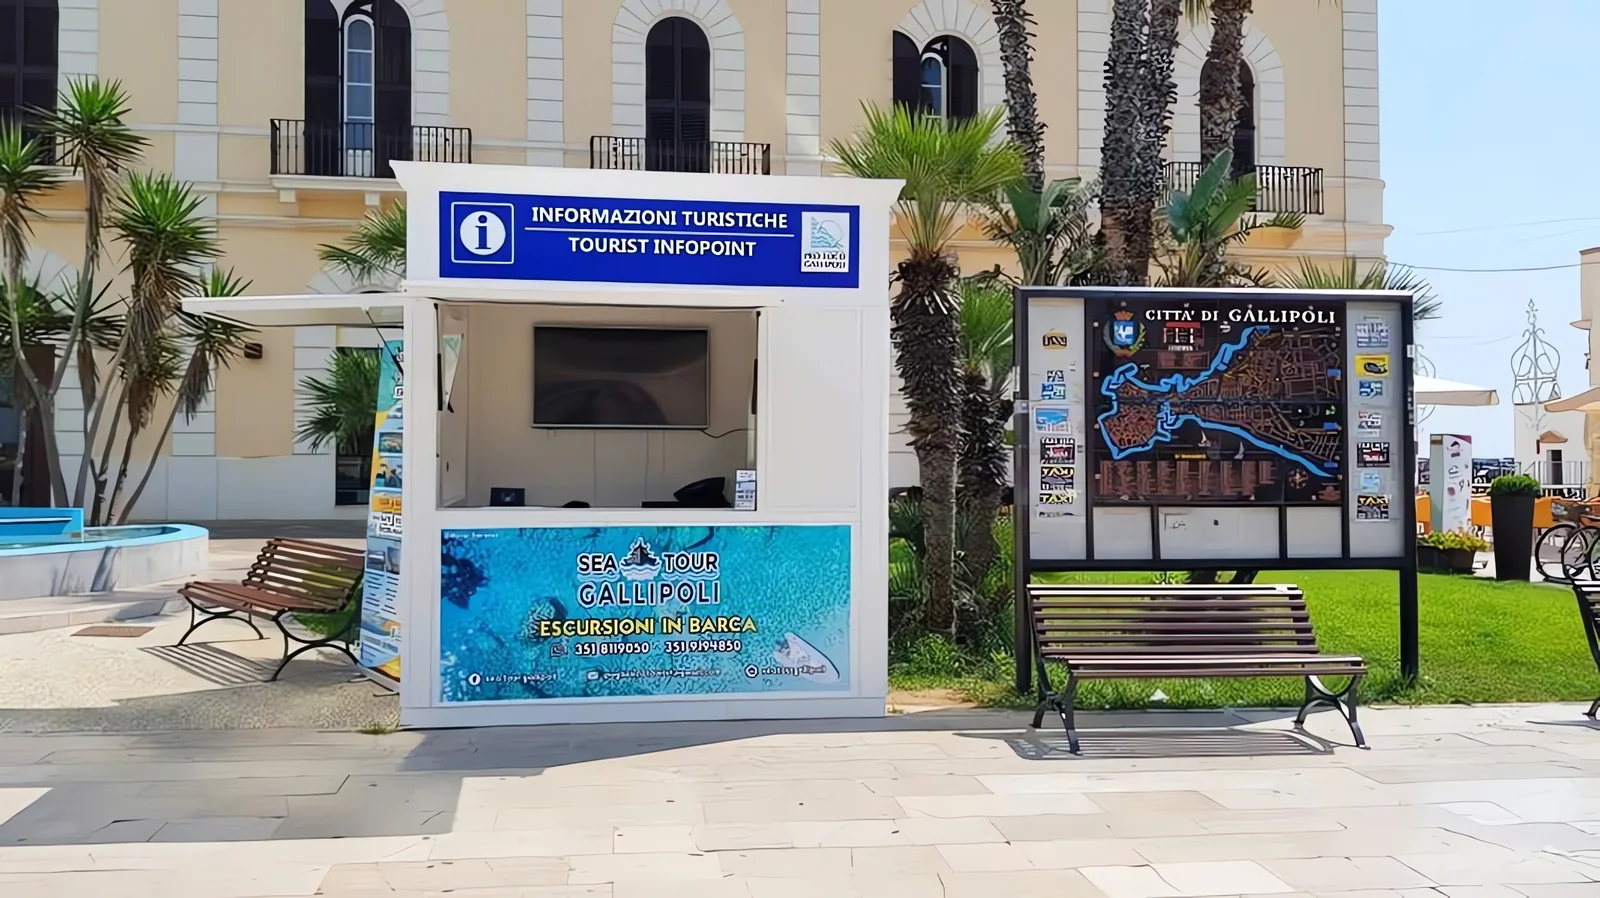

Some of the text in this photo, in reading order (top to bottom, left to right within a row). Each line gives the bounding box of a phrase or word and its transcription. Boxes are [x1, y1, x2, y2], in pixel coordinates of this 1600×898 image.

[531, 206, 788, 228] INFORMAZIONI TURISTICHE
[568, 236, 757, 257] TOURIST INFOPOINT
[1201, 310, 1218, 321] DI
[1228, 308, 1335, 323] GALLIPOLI
[578, 553, 719, 573] SEA TOUR
[579, 581, 720, 606] GALLIPOLI
[539, 616, 758, 636] ESCURSIONI IN BARCA
[575, 642, 597, 655] 351
[665, 641, 686, 653] 351
